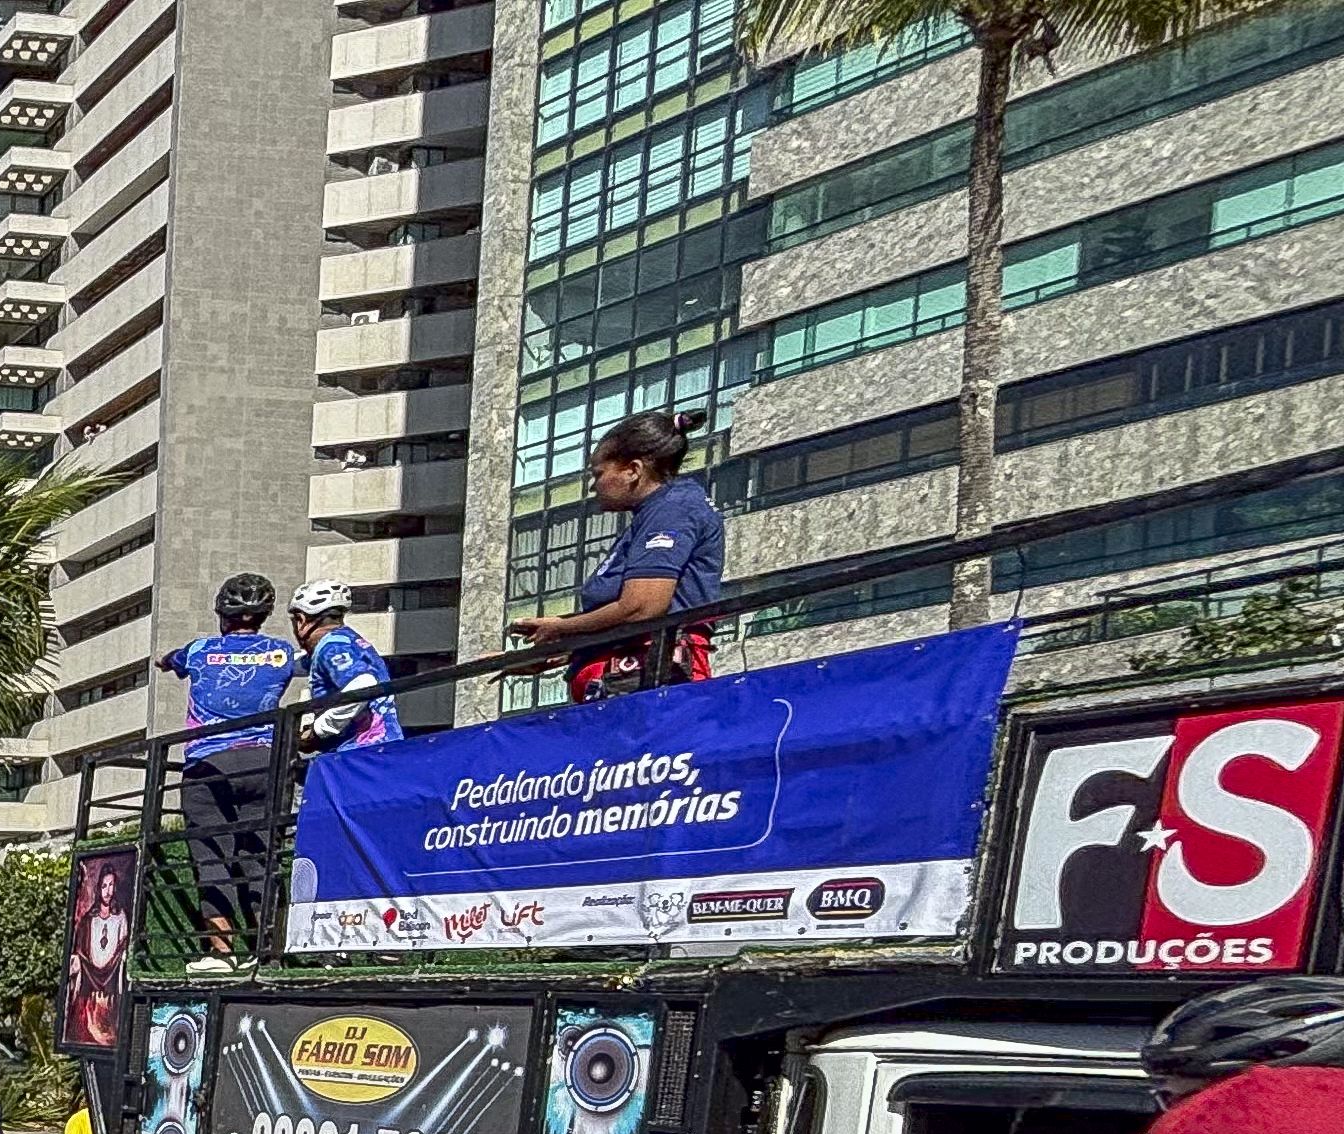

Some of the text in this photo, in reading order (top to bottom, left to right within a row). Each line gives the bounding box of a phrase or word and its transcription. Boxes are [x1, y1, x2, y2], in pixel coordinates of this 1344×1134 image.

[450, 751, 701, 811] Pedalando juntos,
[424, 786, 742, 850] construindo memórias
[691, 896, 785, 915] BEM-ME-QUER
[1013, 932, 1274, 970] PRODUÇÕES
[344, 1026, 368, 1040] DJ
[296, 1034, 413, 1069] FÁBIO SOM
